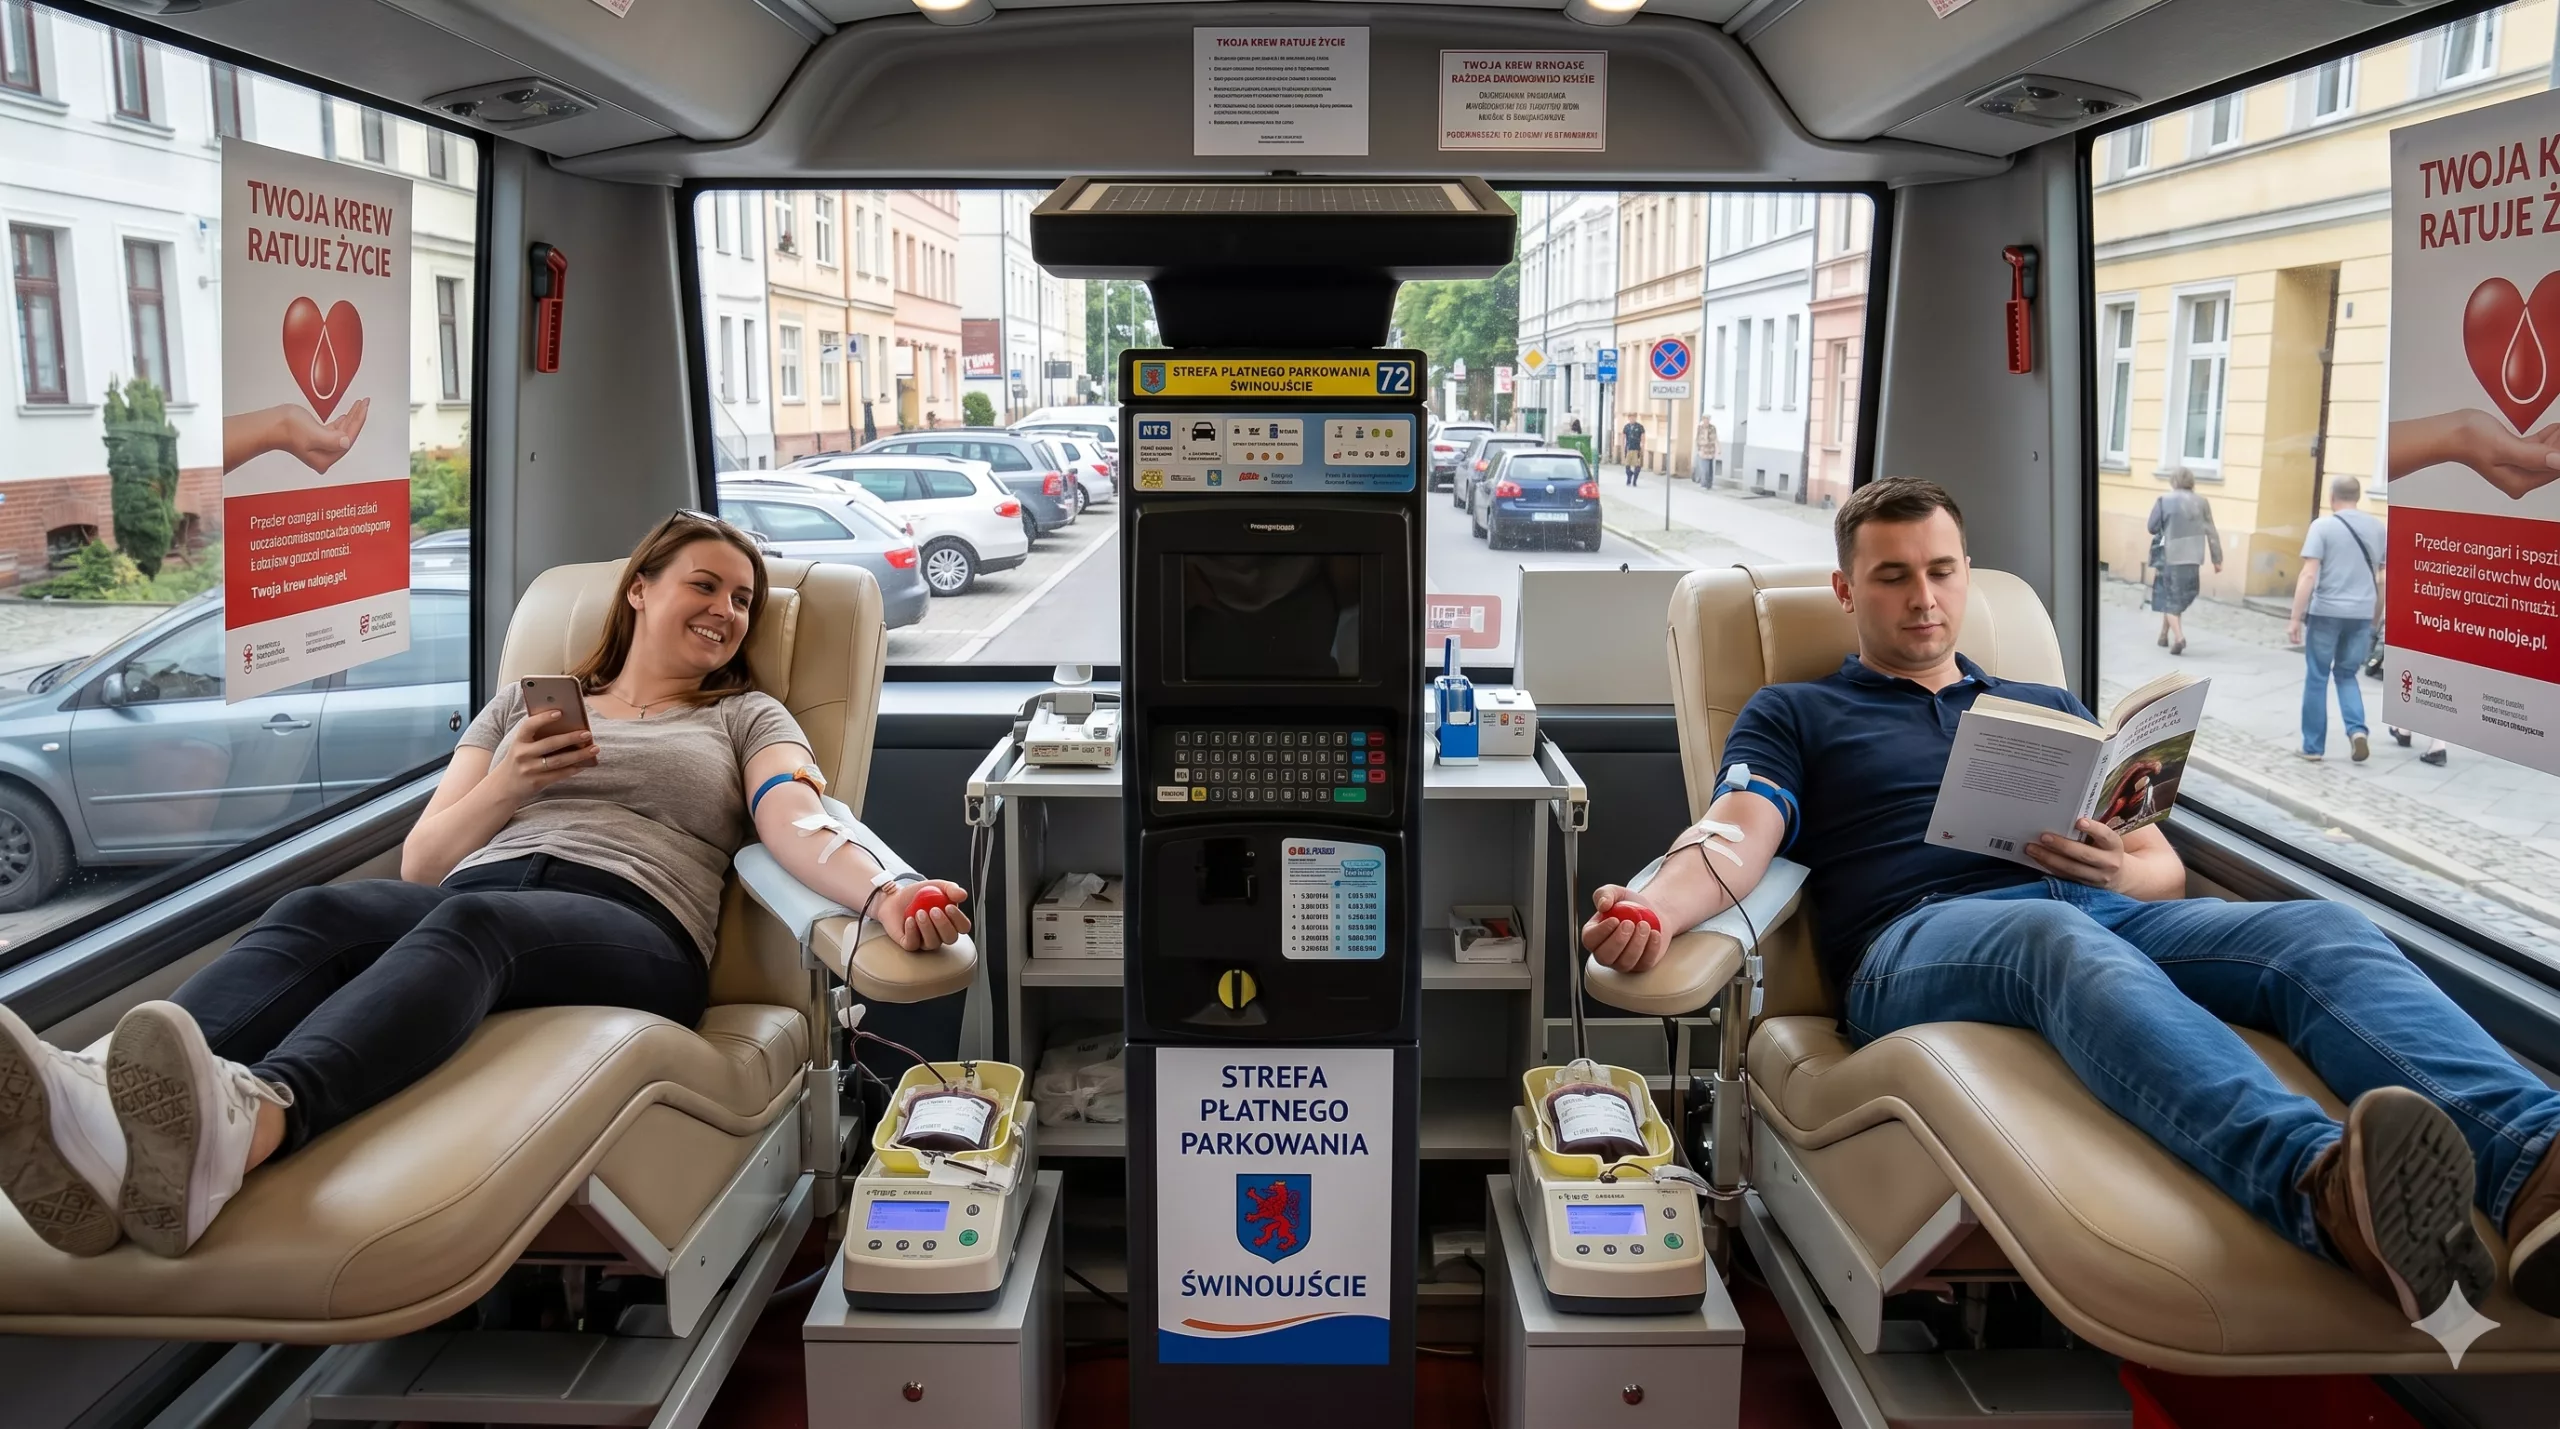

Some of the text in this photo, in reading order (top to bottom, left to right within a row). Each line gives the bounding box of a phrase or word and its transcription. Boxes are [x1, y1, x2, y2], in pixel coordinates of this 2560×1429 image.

[1217, 36, 1346, 47] TKOJA KREW RATUJE ŻYCIE
[1463, 60, 1501, 70] TWOJA
[2419, 142, 2531, 199] TWOJA
[247, 179, 393, 236] TWOJA KREW
[2420, 196, 2534, 250] RATUJE
[248, 227, 391, 278] RATUJE ŻYCIE
[1173, 366, 1218, 377] STREFA
[1289, 366, 1371, 377] PARKOWANIA
[1379, 366, 1410, 392] 72
[1230, 379, 1313, 392] ŚWINOUJŚCIE
[1142, 425, 1168, 436] NTS
[2516, 544, 2520, 560] i
[251, 581, 281, 599] Twoja
[283, 579, 306, 593] krew
[2413, 610, 2548, 652] Twoja krew noloje.pl.
[1221, 1065, 1328, 1089] STREFA
[1200, 1099, 1350, 1122] PŁATNEGO
[1181, 1131, 1370, 1156] PARKOWANIA
[1181, 1269, 1368, 1298] ŚWINOUJŚCIE
